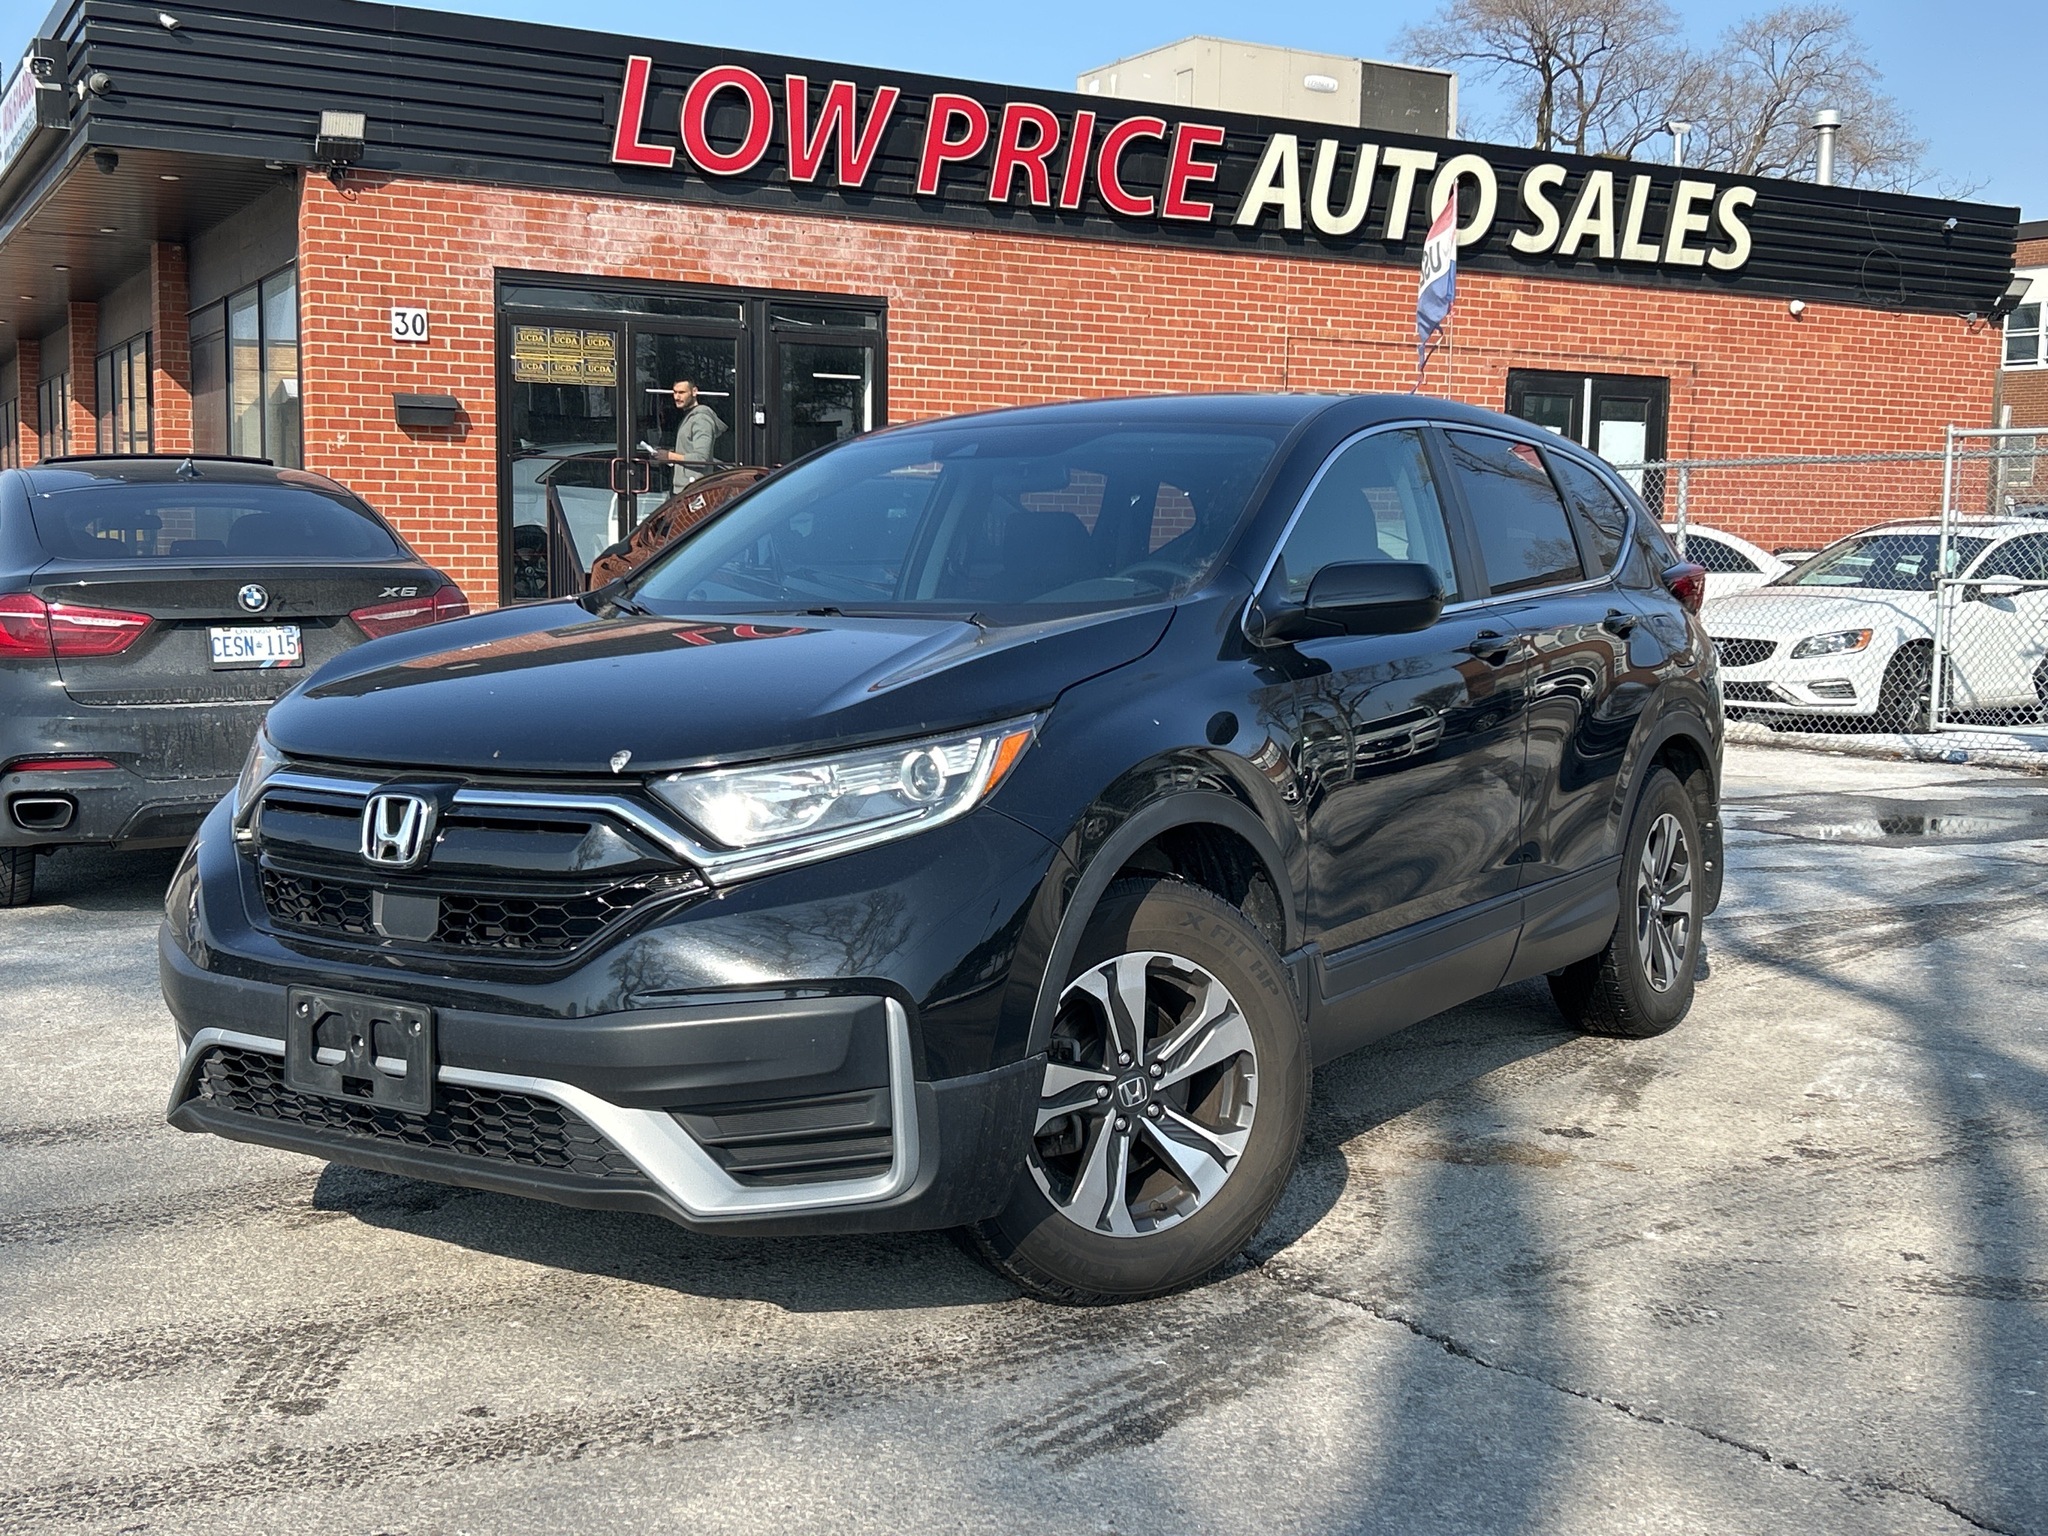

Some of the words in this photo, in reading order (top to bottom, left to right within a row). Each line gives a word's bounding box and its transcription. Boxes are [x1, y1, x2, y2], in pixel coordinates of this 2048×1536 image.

[612, 55, 900, 187] LOW
[916, 93, 1226, 222] PRICE
[1235, 132, 1498, 247] AUTO
[1510, 163, 1758, 270] SALES
[395, 312, 426, 337] 30
[520, 333, 544, 342] UCDA
[554, 336, 578, 345] UCDA
[587, 339, 611, 347] UCDA
[521, 362, 545, 371] UCDA
[554, 364, 578, 372] UCDA
[588, 365, 612, 373] UCDA
[378, 586, 418, 598] X6
[212, 635, 255, 657] CESN
[267, 634, 297, 656] 115
[1180, 911, 1205, 932] X
[1210, 924, 1252, 958] FIT
[1249, 960, 1280, 997] HP
